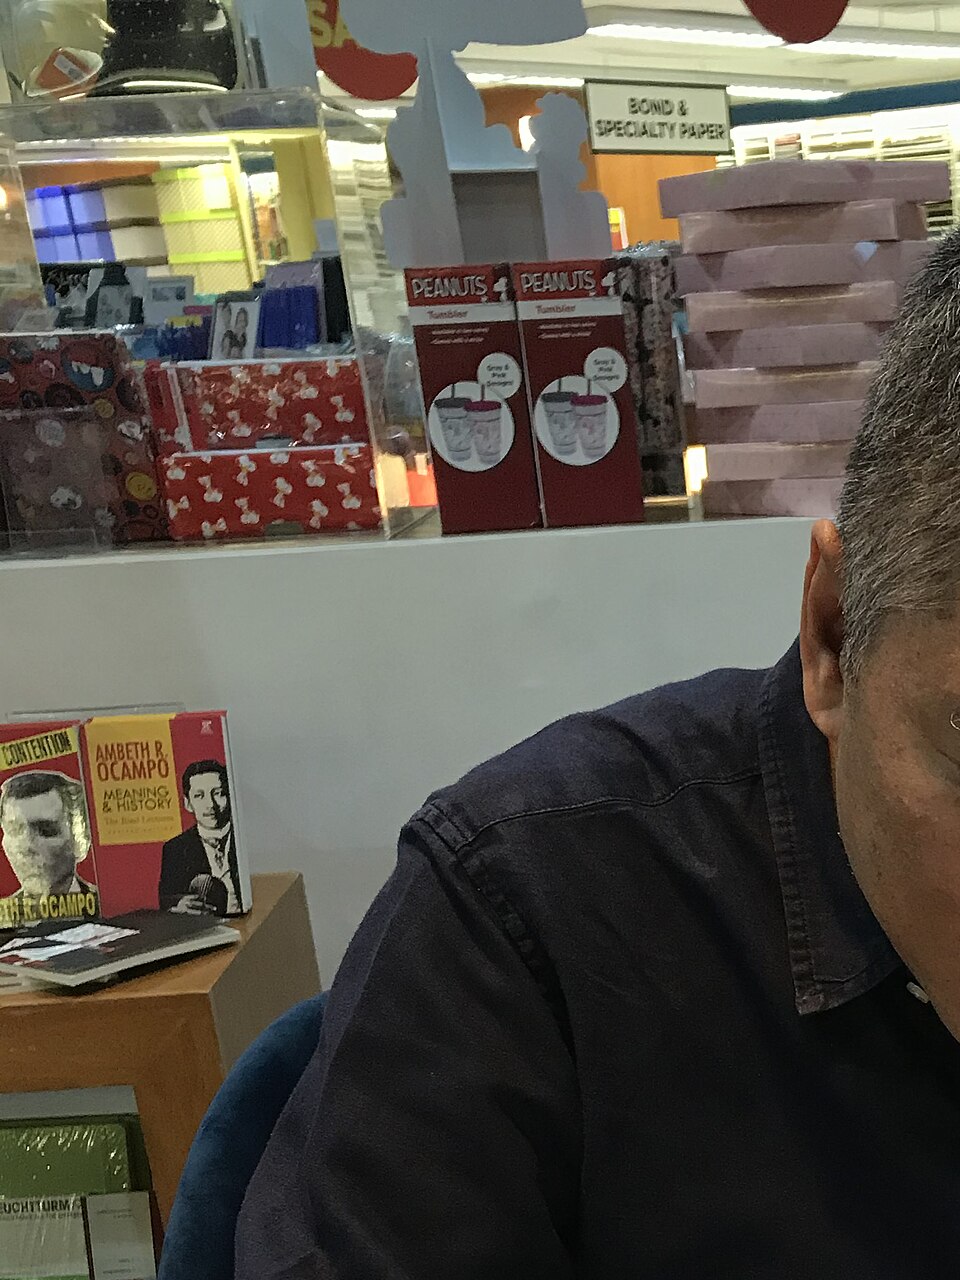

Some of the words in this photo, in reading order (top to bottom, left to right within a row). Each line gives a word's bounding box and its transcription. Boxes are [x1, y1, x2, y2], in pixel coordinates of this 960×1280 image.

[627, 97, 675, 116] BOND
[677, 99, 689, 116] &
[594, 119, 676, 139] SPECIALTY
[679, 122, 726, 140] PAPER
[412, 274, 488, 299] PEANUTS
[520, 269, 597, 294] PEANUTS
[427, 308, 469, 321] Tumbler
[535, 303, 576, 316] Tumbler
[1, 728, 73, 767] CONTENTION
[95, 741, 150, 762] AMBETH
[155, 739, 168, 760] R.
[97, 760, 170, 782] OCAMPO
[104, 785, 170, 801] MEANING
[102, 801, 113, 814] &
[117, 797, 173, 813] HISTORY
[40, 891, 96, 918] OCAMPO
